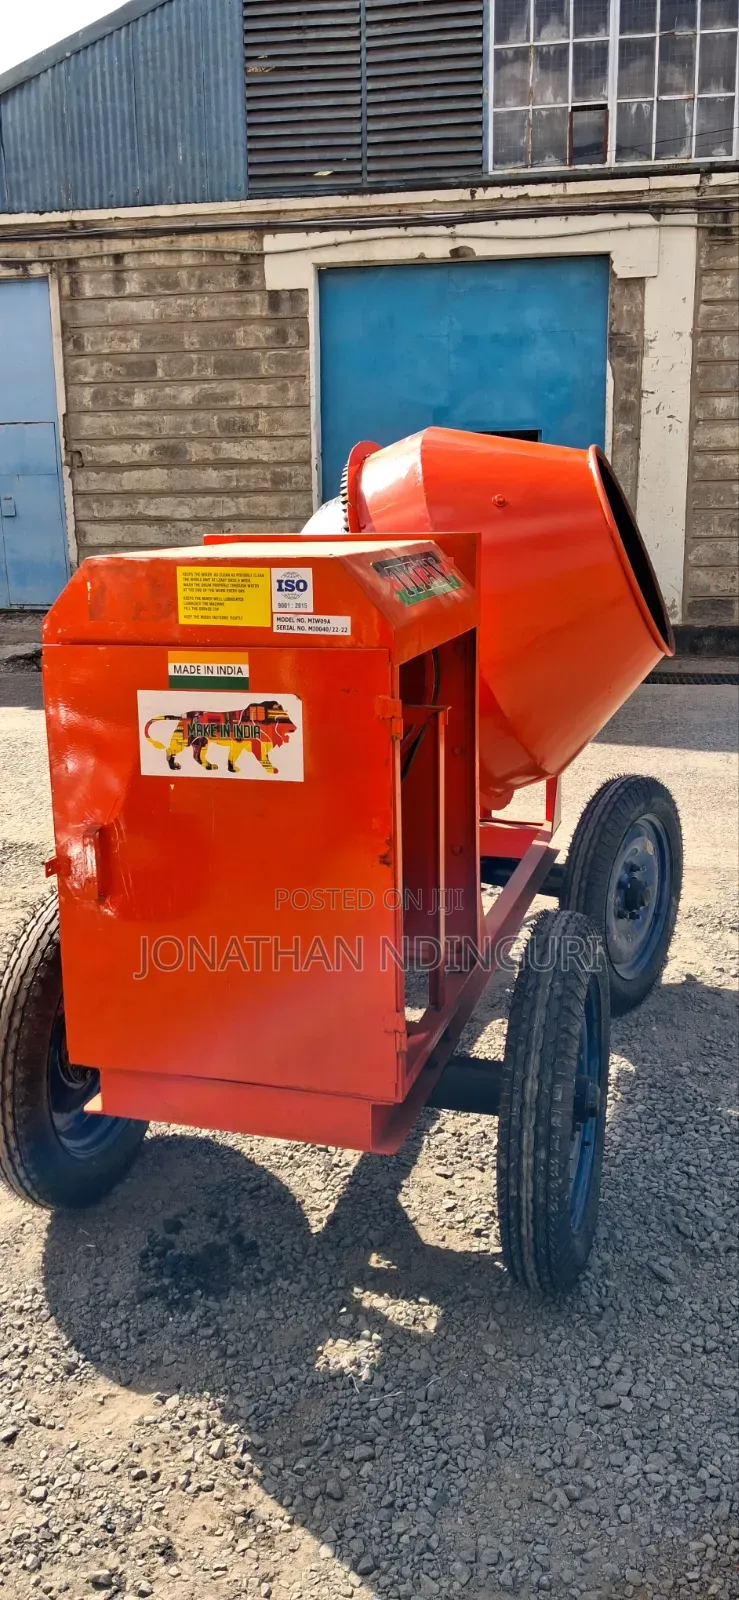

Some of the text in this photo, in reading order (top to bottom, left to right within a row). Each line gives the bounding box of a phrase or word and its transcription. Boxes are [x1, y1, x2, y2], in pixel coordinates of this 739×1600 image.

[383, 557, 453, 597] TITAN
[276, 579, 308, 592] ISO
[173, 665, 244, 676] MADE IN INDIA
[187, 723, 261, 739] MAKE IN INDIA
